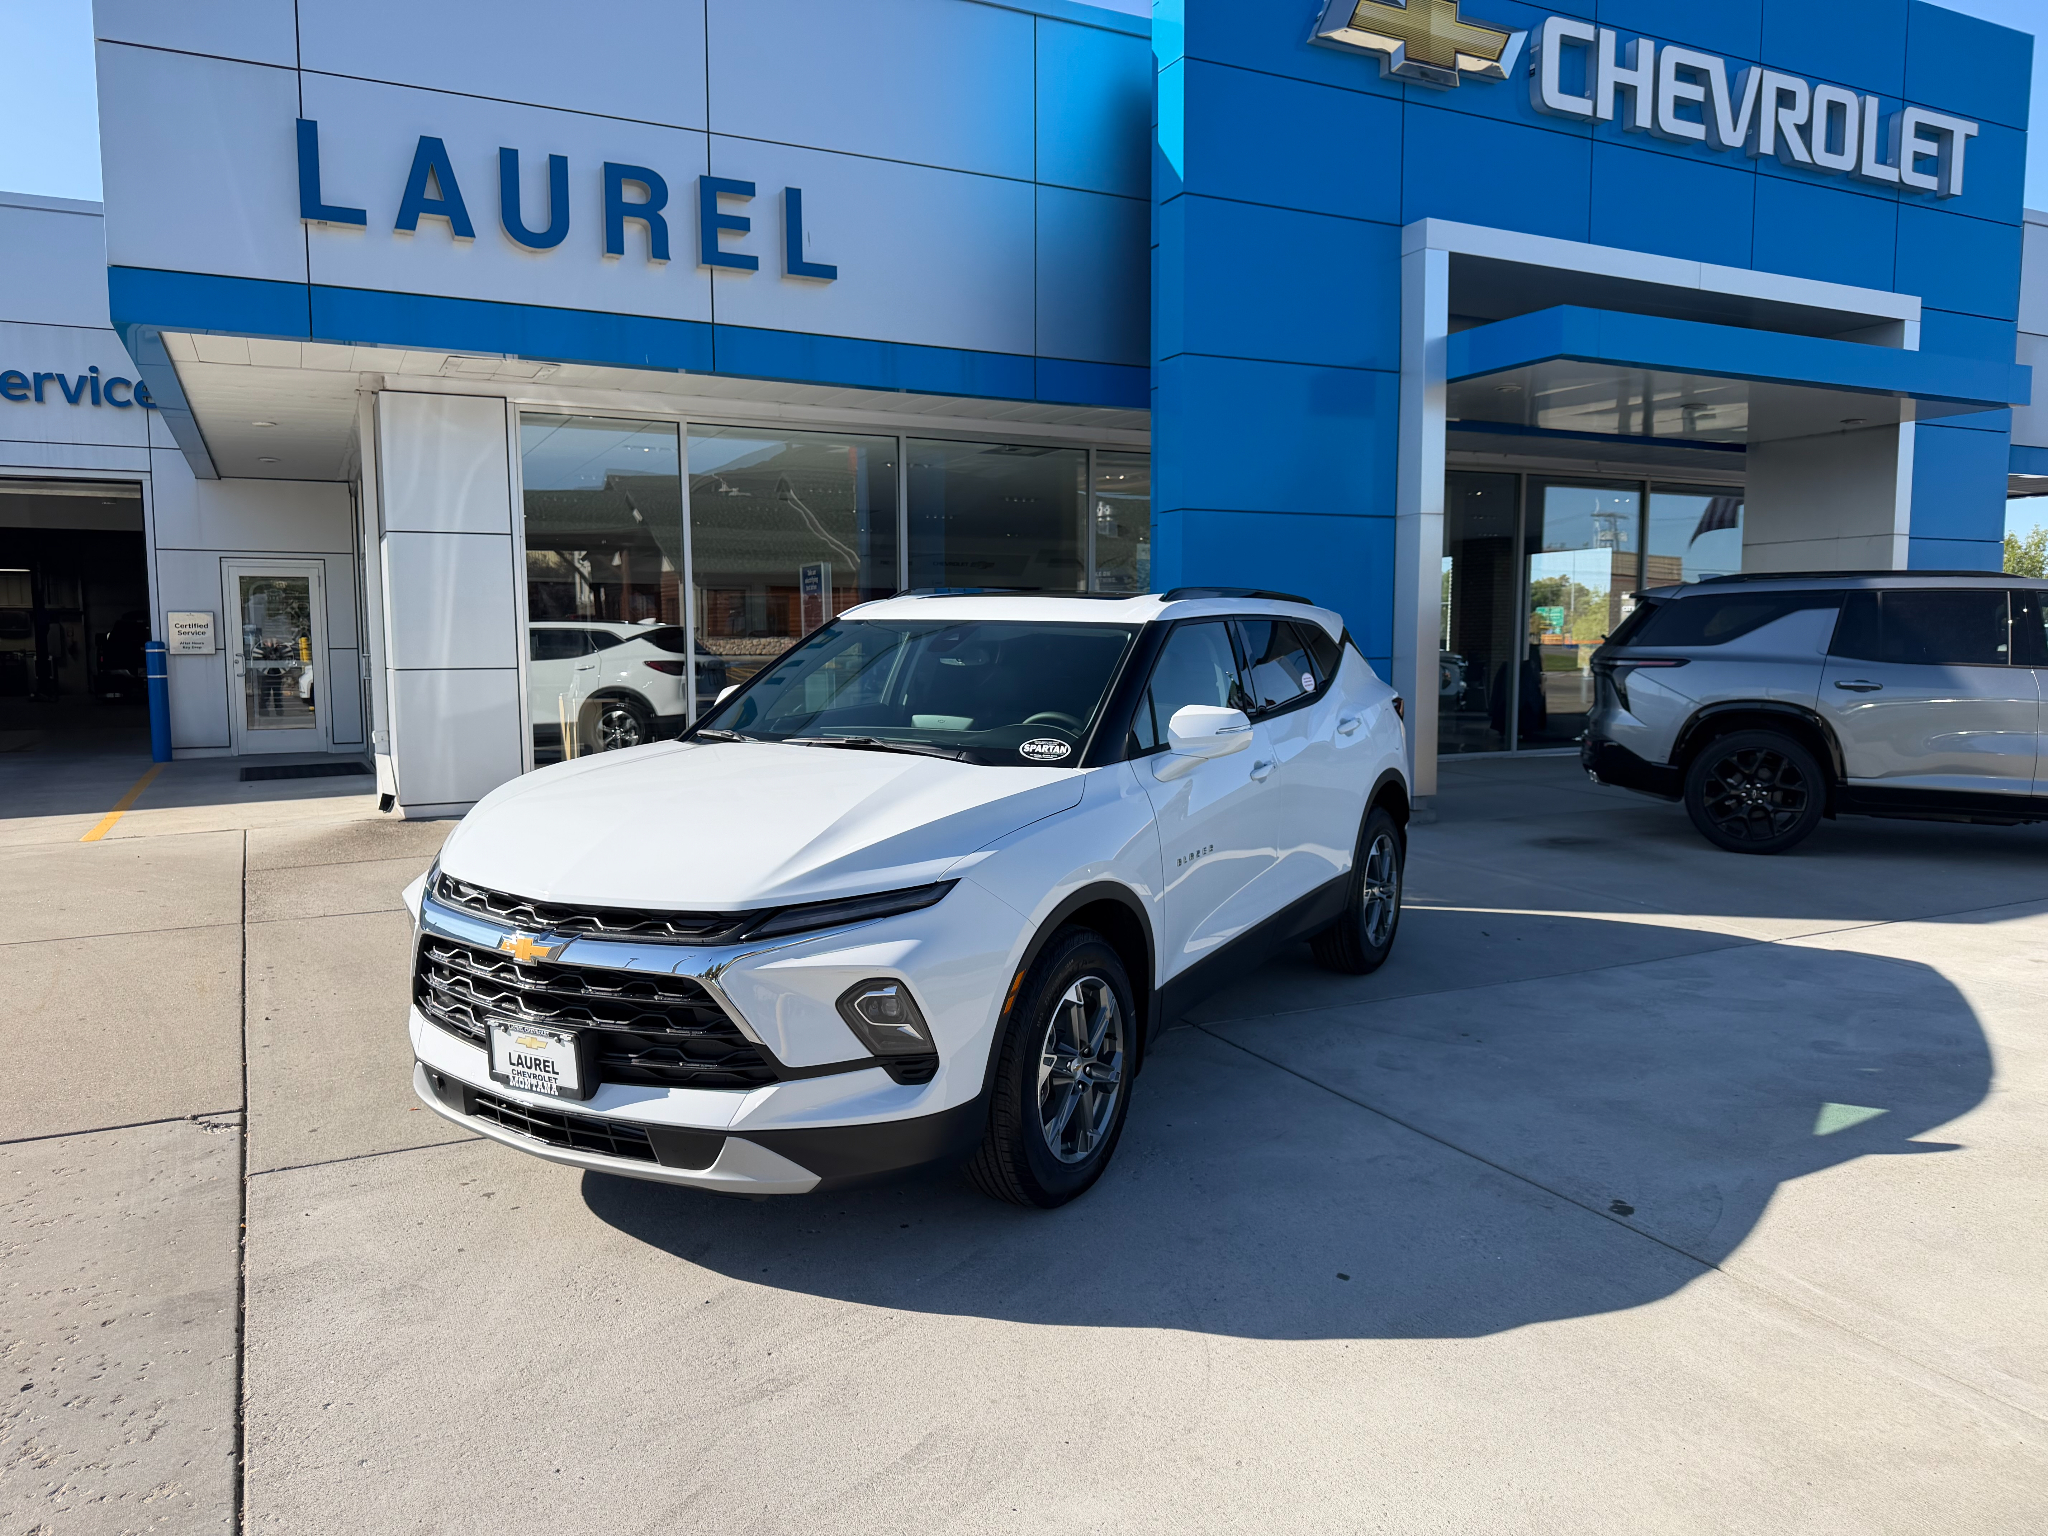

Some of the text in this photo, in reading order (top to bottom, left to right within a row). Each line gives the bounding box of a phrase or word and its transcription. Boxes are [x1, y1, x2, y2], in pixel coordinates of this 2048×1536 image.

[1531, 15, 1979, 199] CHEVROLET
[295, 118, 838, 284] LAUREL
[0, 365, 158, 409] ervice
[1023, 744, 1067, 753] SPARTAN
[508, 1052, 560, 1076] LAUREL
[511, 1068, 559, 1084] CHEVROLET
[509, 1075, 559, 1096] MONTANA
